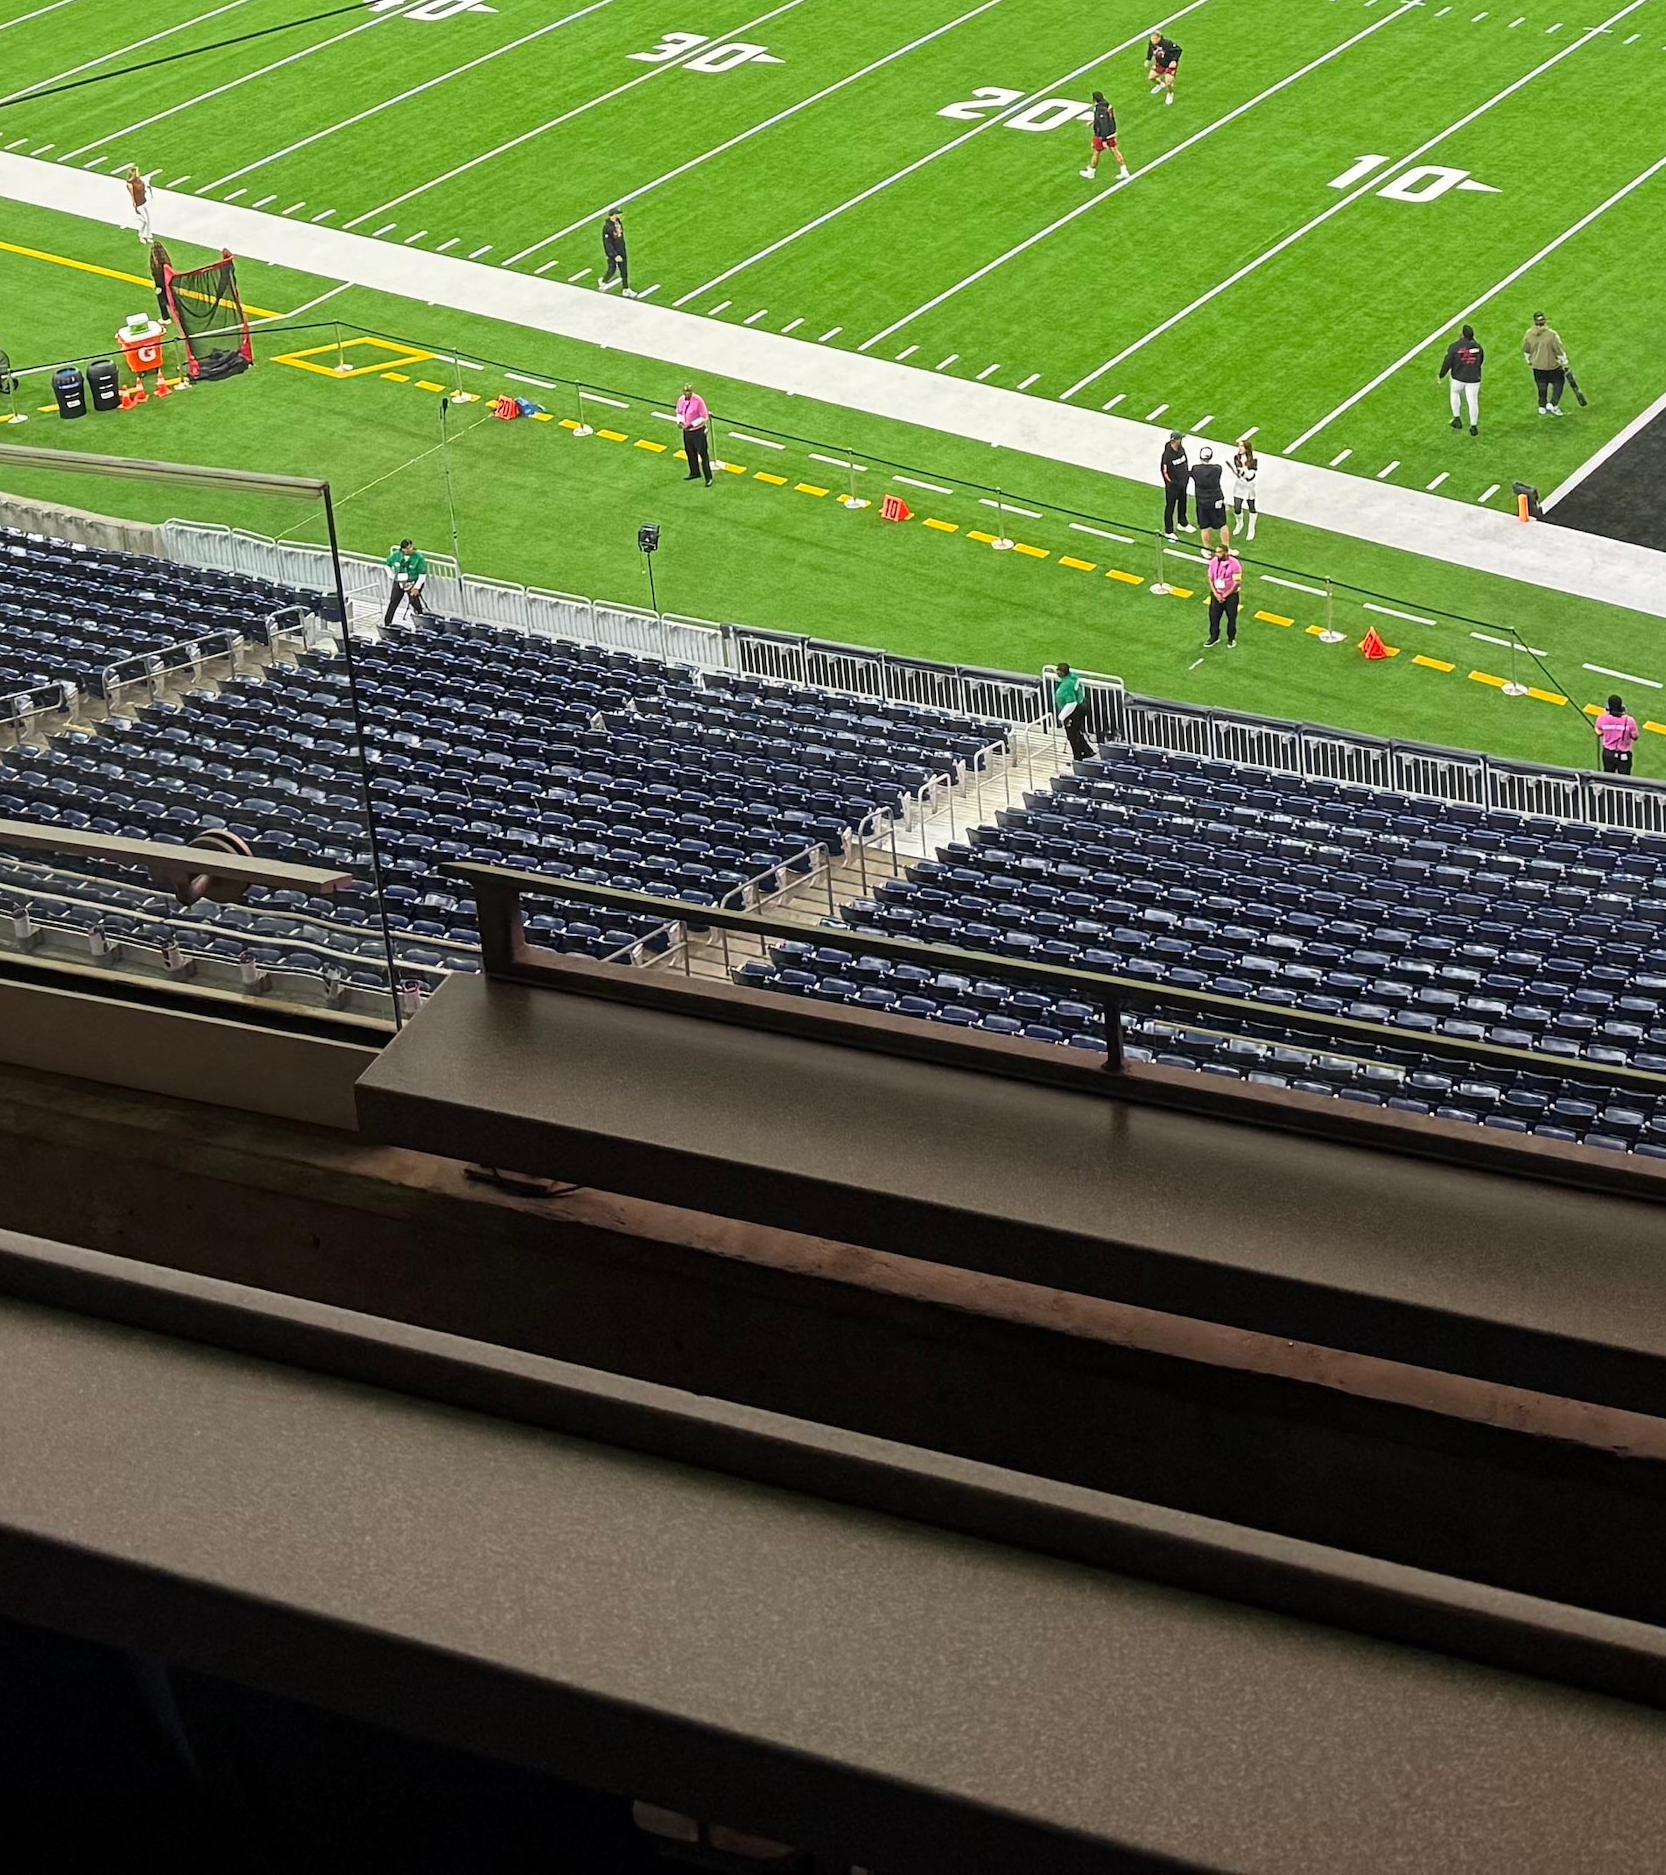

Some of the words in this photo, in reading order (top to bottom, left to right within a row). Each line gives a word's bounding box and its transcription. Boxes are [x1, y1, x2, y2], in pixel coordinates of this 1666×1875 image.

[627, 32, 758, 72] 30
[936, 86, 1088, 133] 20
[1326, 153, 1475, 205] 10
